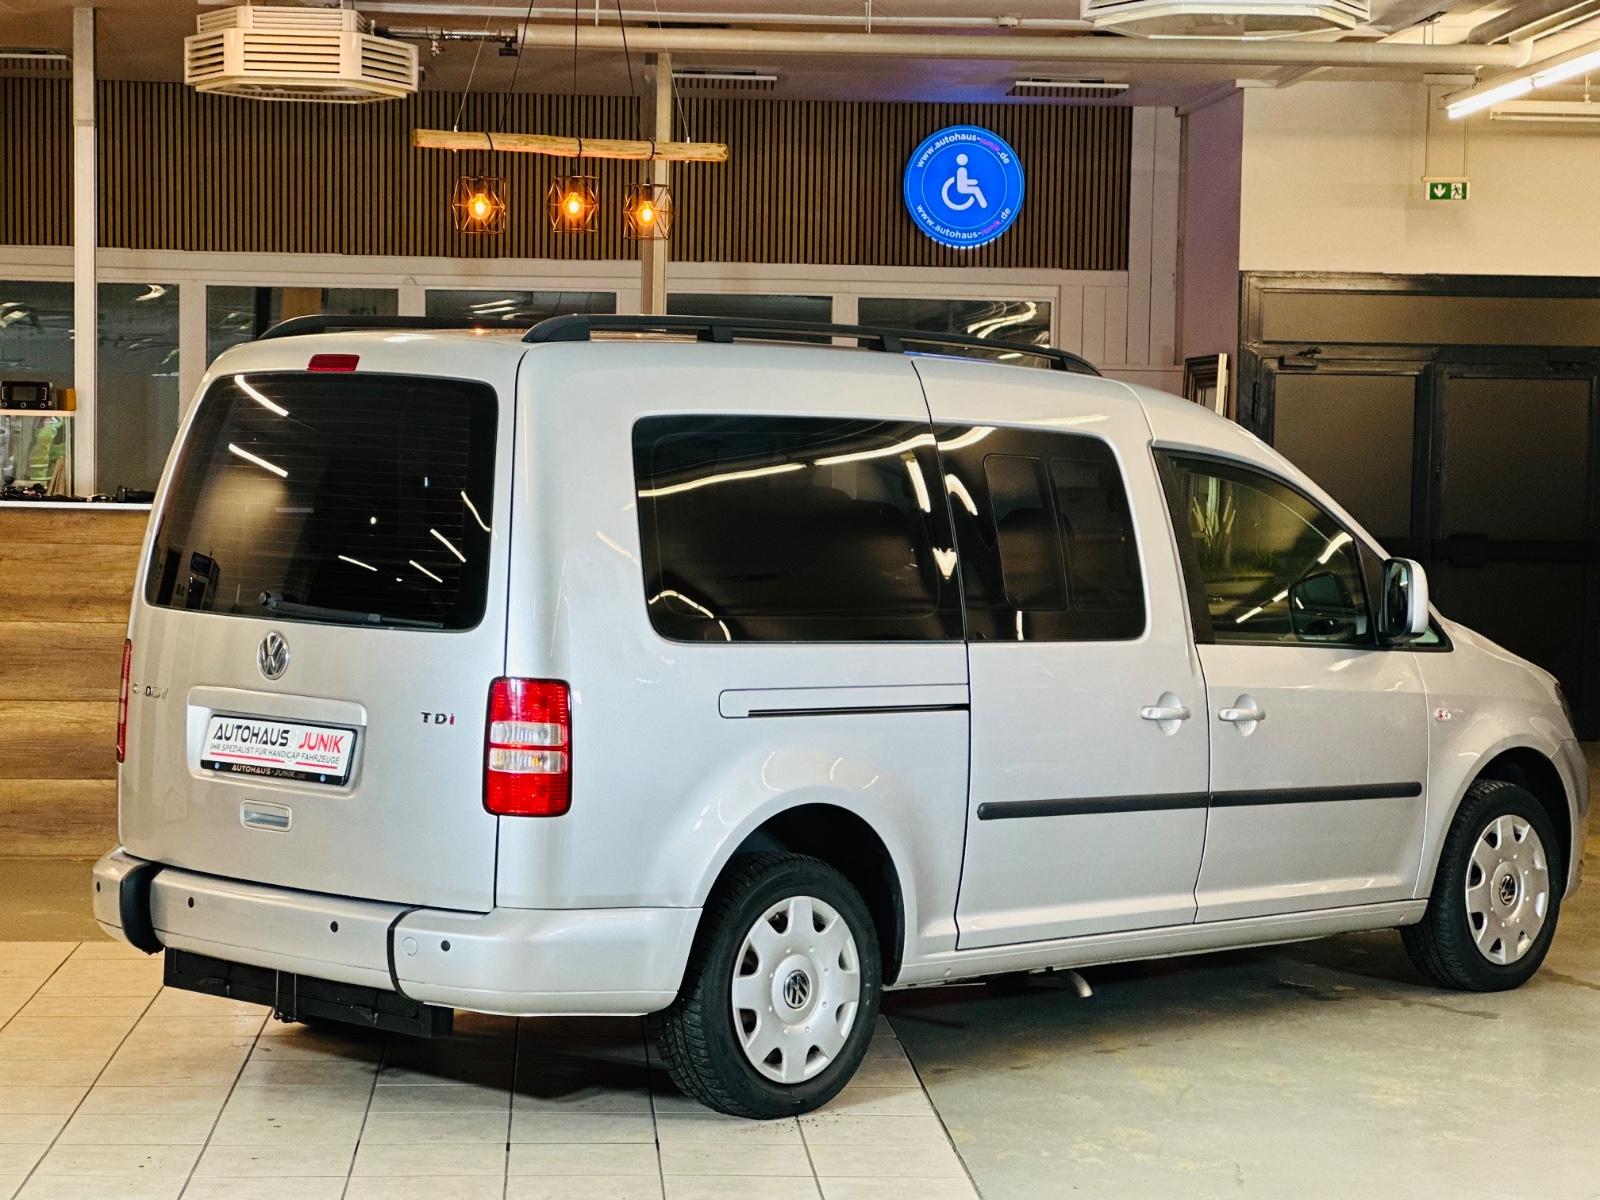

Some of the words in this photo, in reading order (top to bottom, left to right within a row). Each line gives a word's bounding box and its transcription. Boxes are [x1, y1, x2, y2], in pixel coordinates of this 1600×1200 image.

[213, 723, 290, 747] AUTOHAUS
[298, 732, 344, 753] JUNIK
[222, 744, 254, 754] SPEZIALIST
[269, 750, 300, 759] HANDICAP
[301, 753, 340, 764] FAHRZEUGE
